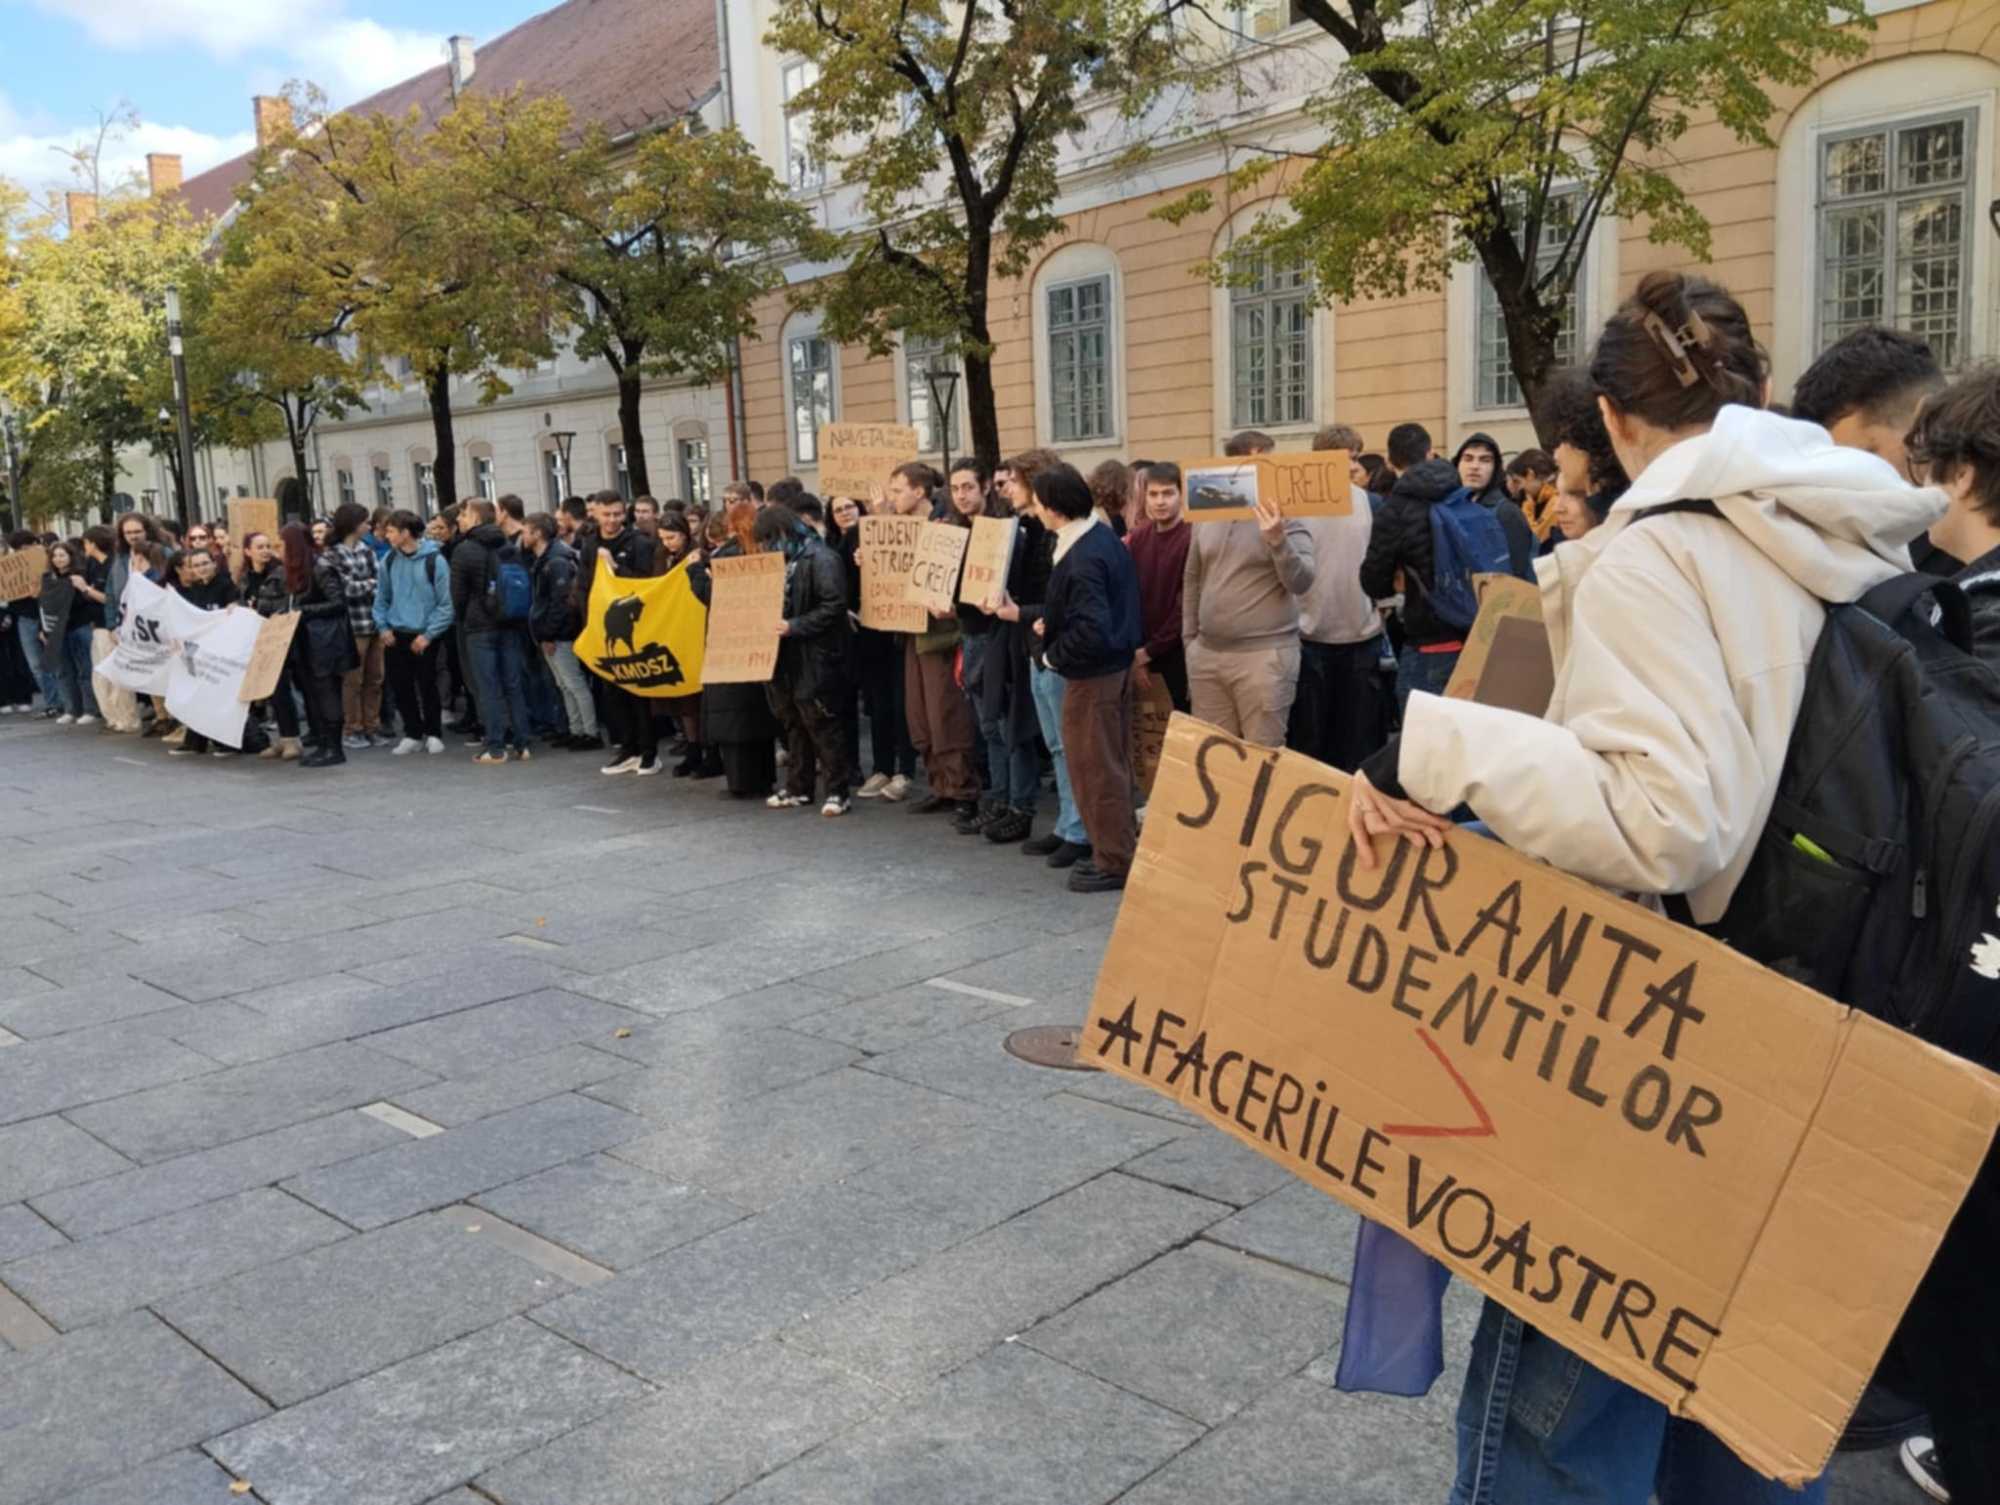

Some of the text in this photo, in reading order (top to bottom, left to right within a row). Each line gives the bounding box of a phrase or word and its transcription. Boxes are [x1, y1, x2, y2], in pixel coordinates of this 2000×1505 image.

[1275, 463, 1342, 506] CREIC
[612, 655, 673, 680] KMDSZ
[1407, 1155, 1720, 1391] VOASTRE
